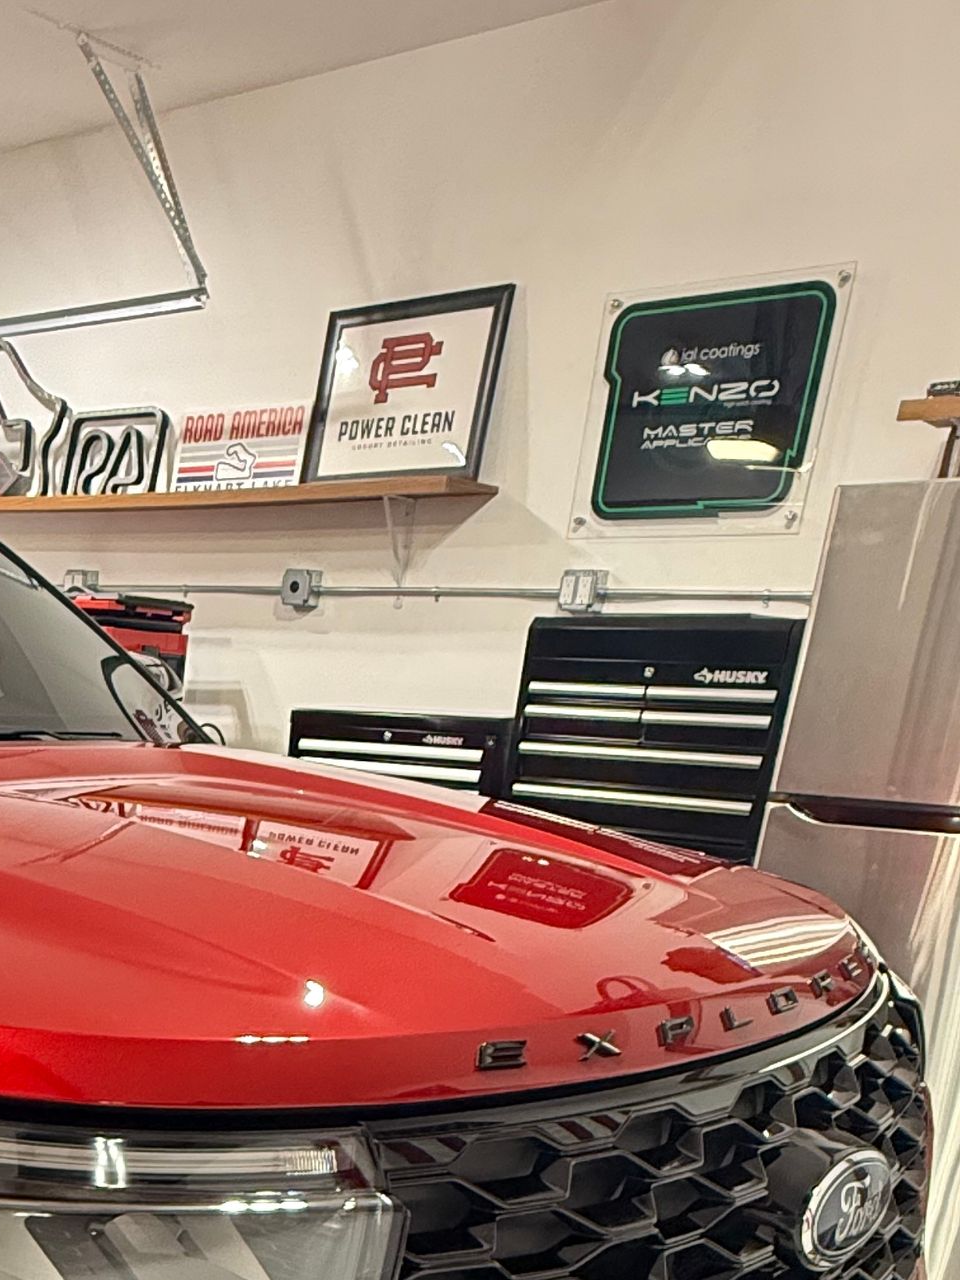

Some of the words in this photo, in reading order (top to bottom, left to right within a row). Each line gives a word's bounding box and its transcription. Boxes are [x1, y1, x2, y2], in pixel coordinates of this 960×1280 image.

[700, 342, 761, 360] coatings
[631, 379, 780, 408] KENZO
[182, 413, 226, 444] ROAD
[229, 405, 306, 441] AMERICA
[337, 416, 396, 442] POWER
[400, 410, 456, 436] CLEAN
[642, 419, 754, 440] MASTER
[713, 669, 769, 684] HUSKY
[433, 735, 464, 746] HUSKY
[835, 1181, 881, 1244] Ford
